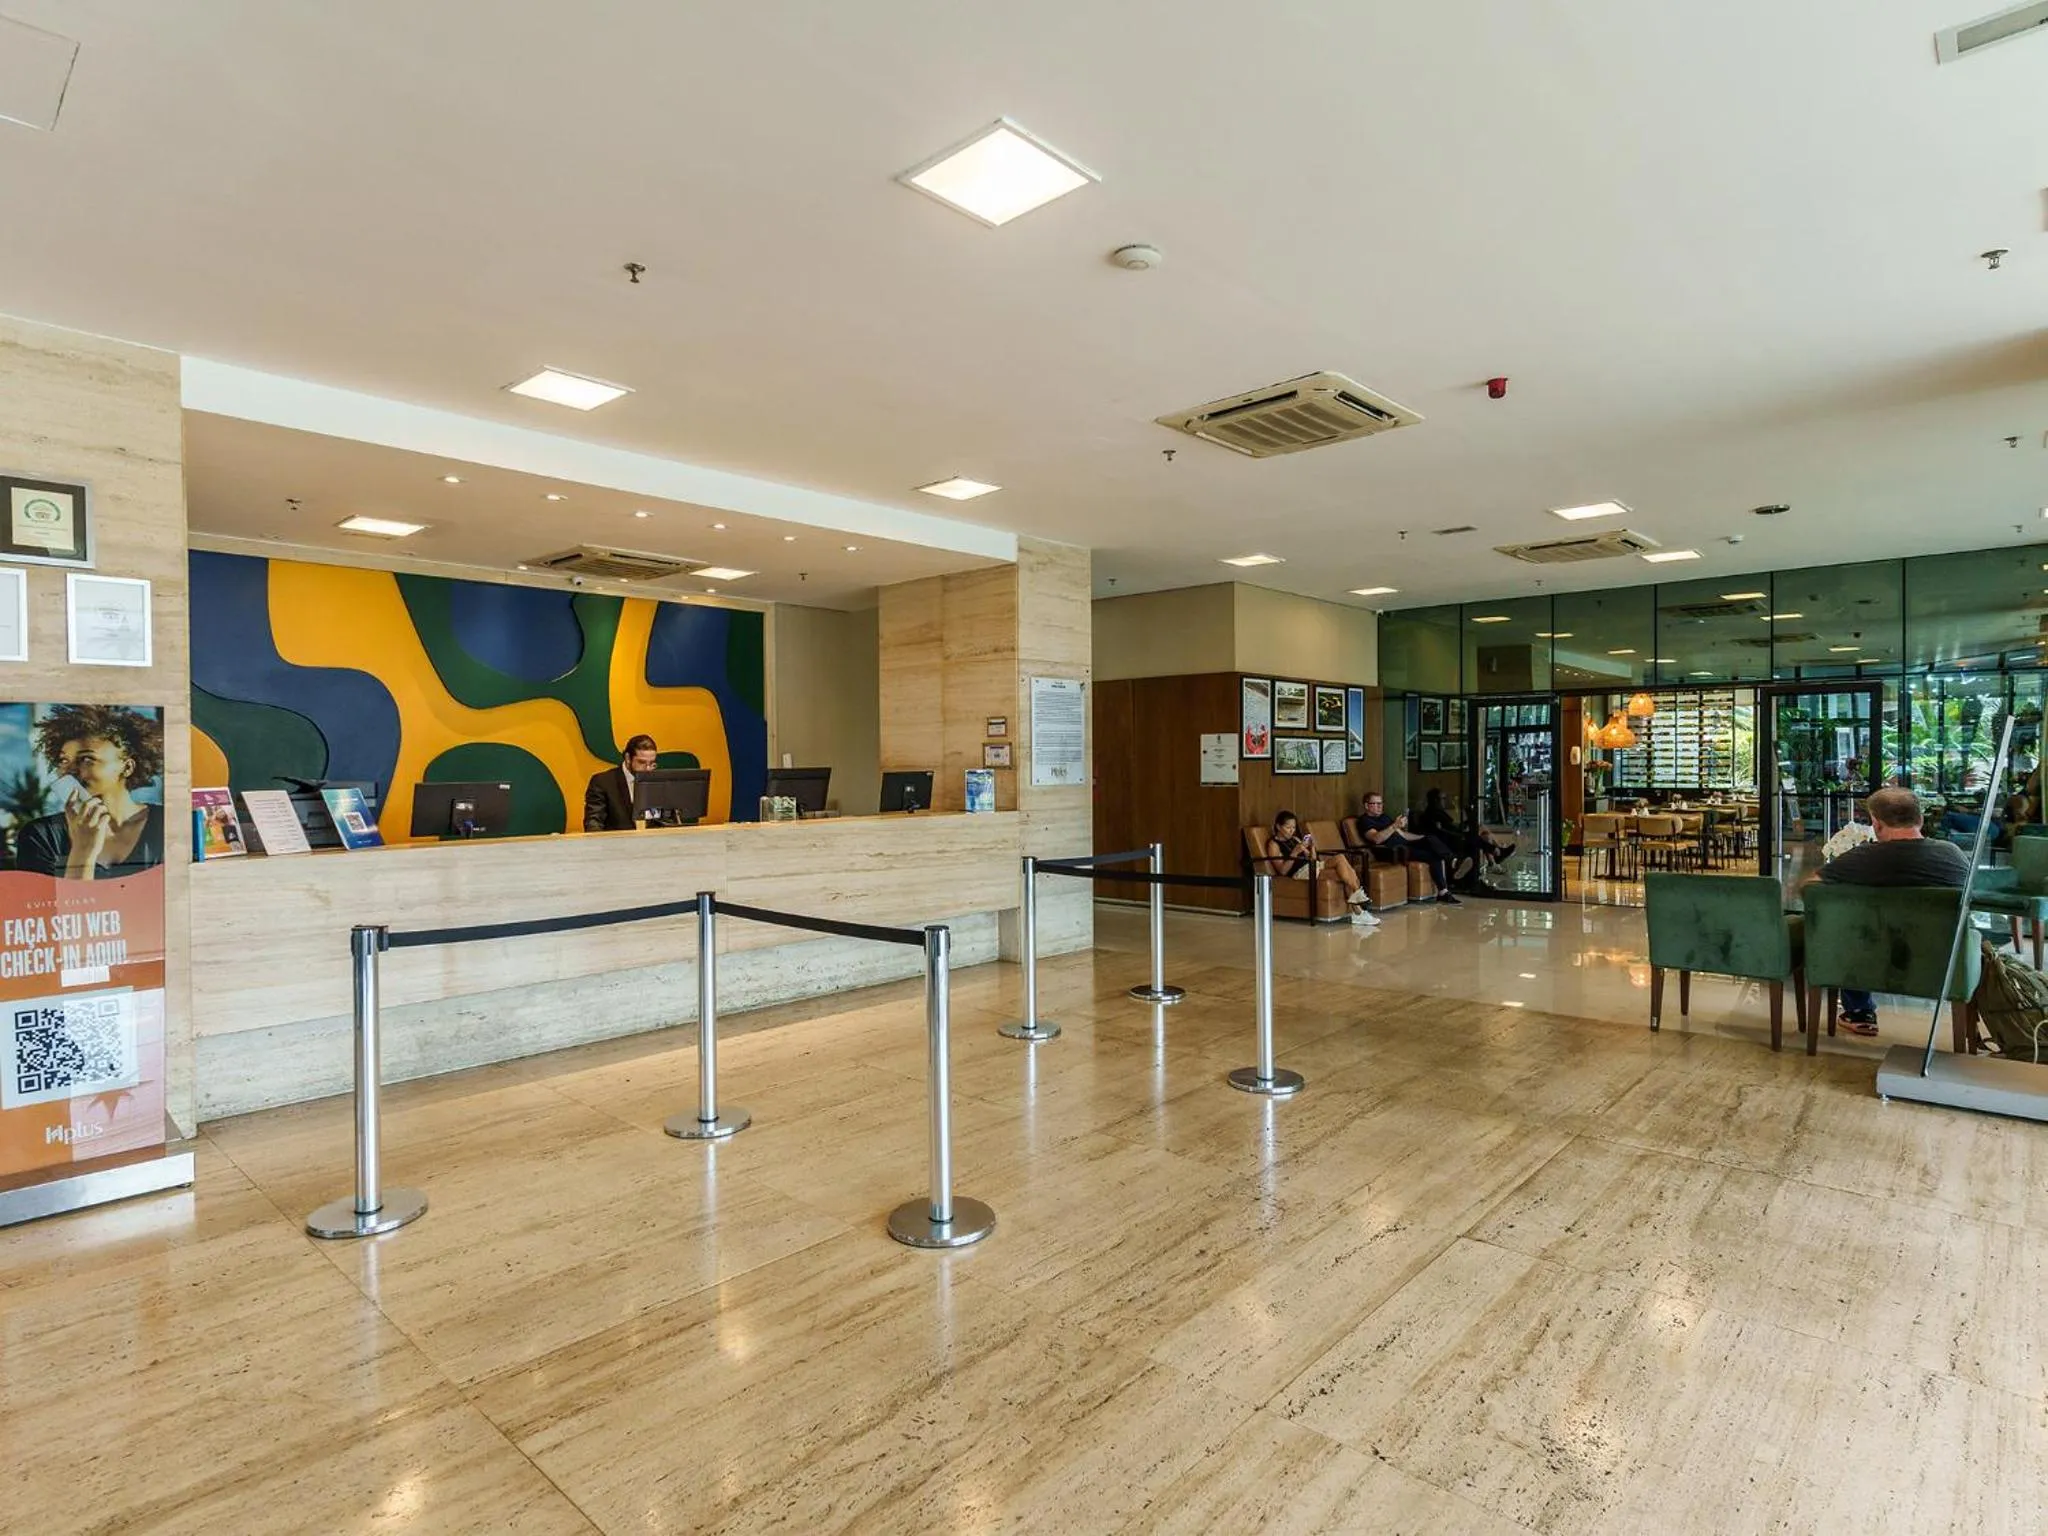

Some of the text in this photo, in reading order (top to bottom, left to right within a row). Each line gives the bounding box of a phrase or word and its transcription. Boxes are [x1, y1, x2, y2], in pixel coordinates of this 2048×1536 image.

[4, 910, 121, 949] FAÇA SEU WEB
[0, 943, 81, 979] CHECK-IN
